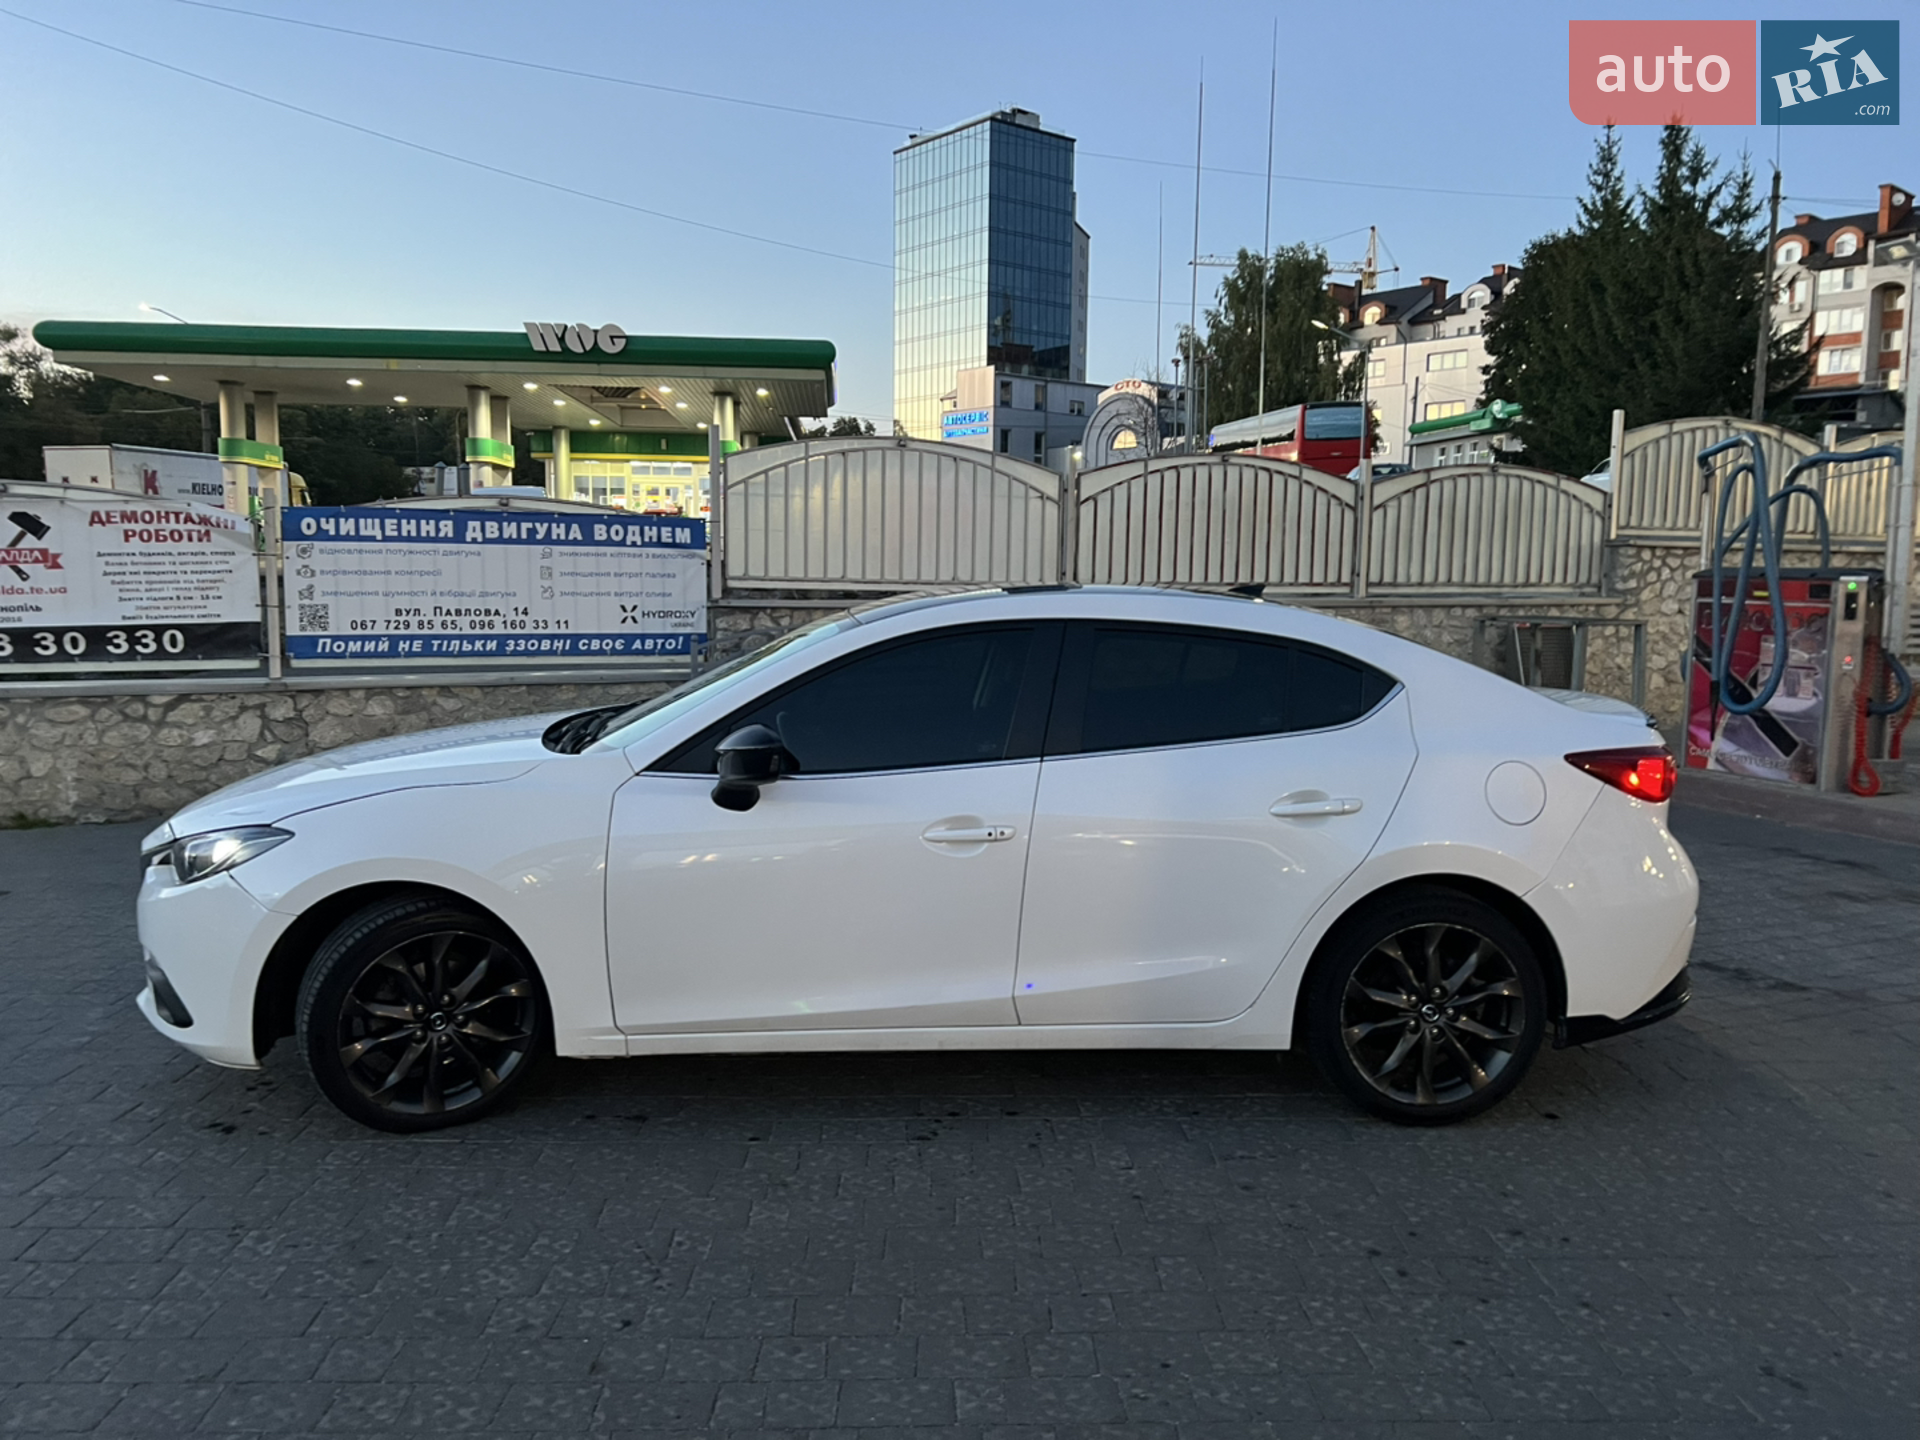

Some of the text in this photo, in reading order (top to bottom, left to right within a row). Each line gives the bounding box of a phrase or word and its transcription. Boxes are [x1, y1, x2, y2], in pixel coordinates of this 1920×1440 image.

[523, 322, 627, 354] WOG
[1114, 379, 1142, 391] СТО
[143, 469, 160, 496] K
[88, 510, 237, 531] ДЕМОНТАЖНІ
[123, 528, 212, 543] РОБОТИ
[300, 516, 691, 546] ОЧИЩЕННЯ ДВИГУНА ВОДНЕМ
[513, 606, 529, 617] 14
[641, 609, 697, 619] HYDROXY
[350, 619, 570, 632] 067 729 85 65, 096 160 33 11
[33, 631, 87, 655] 30
[105, 628, 186, 654] 330
